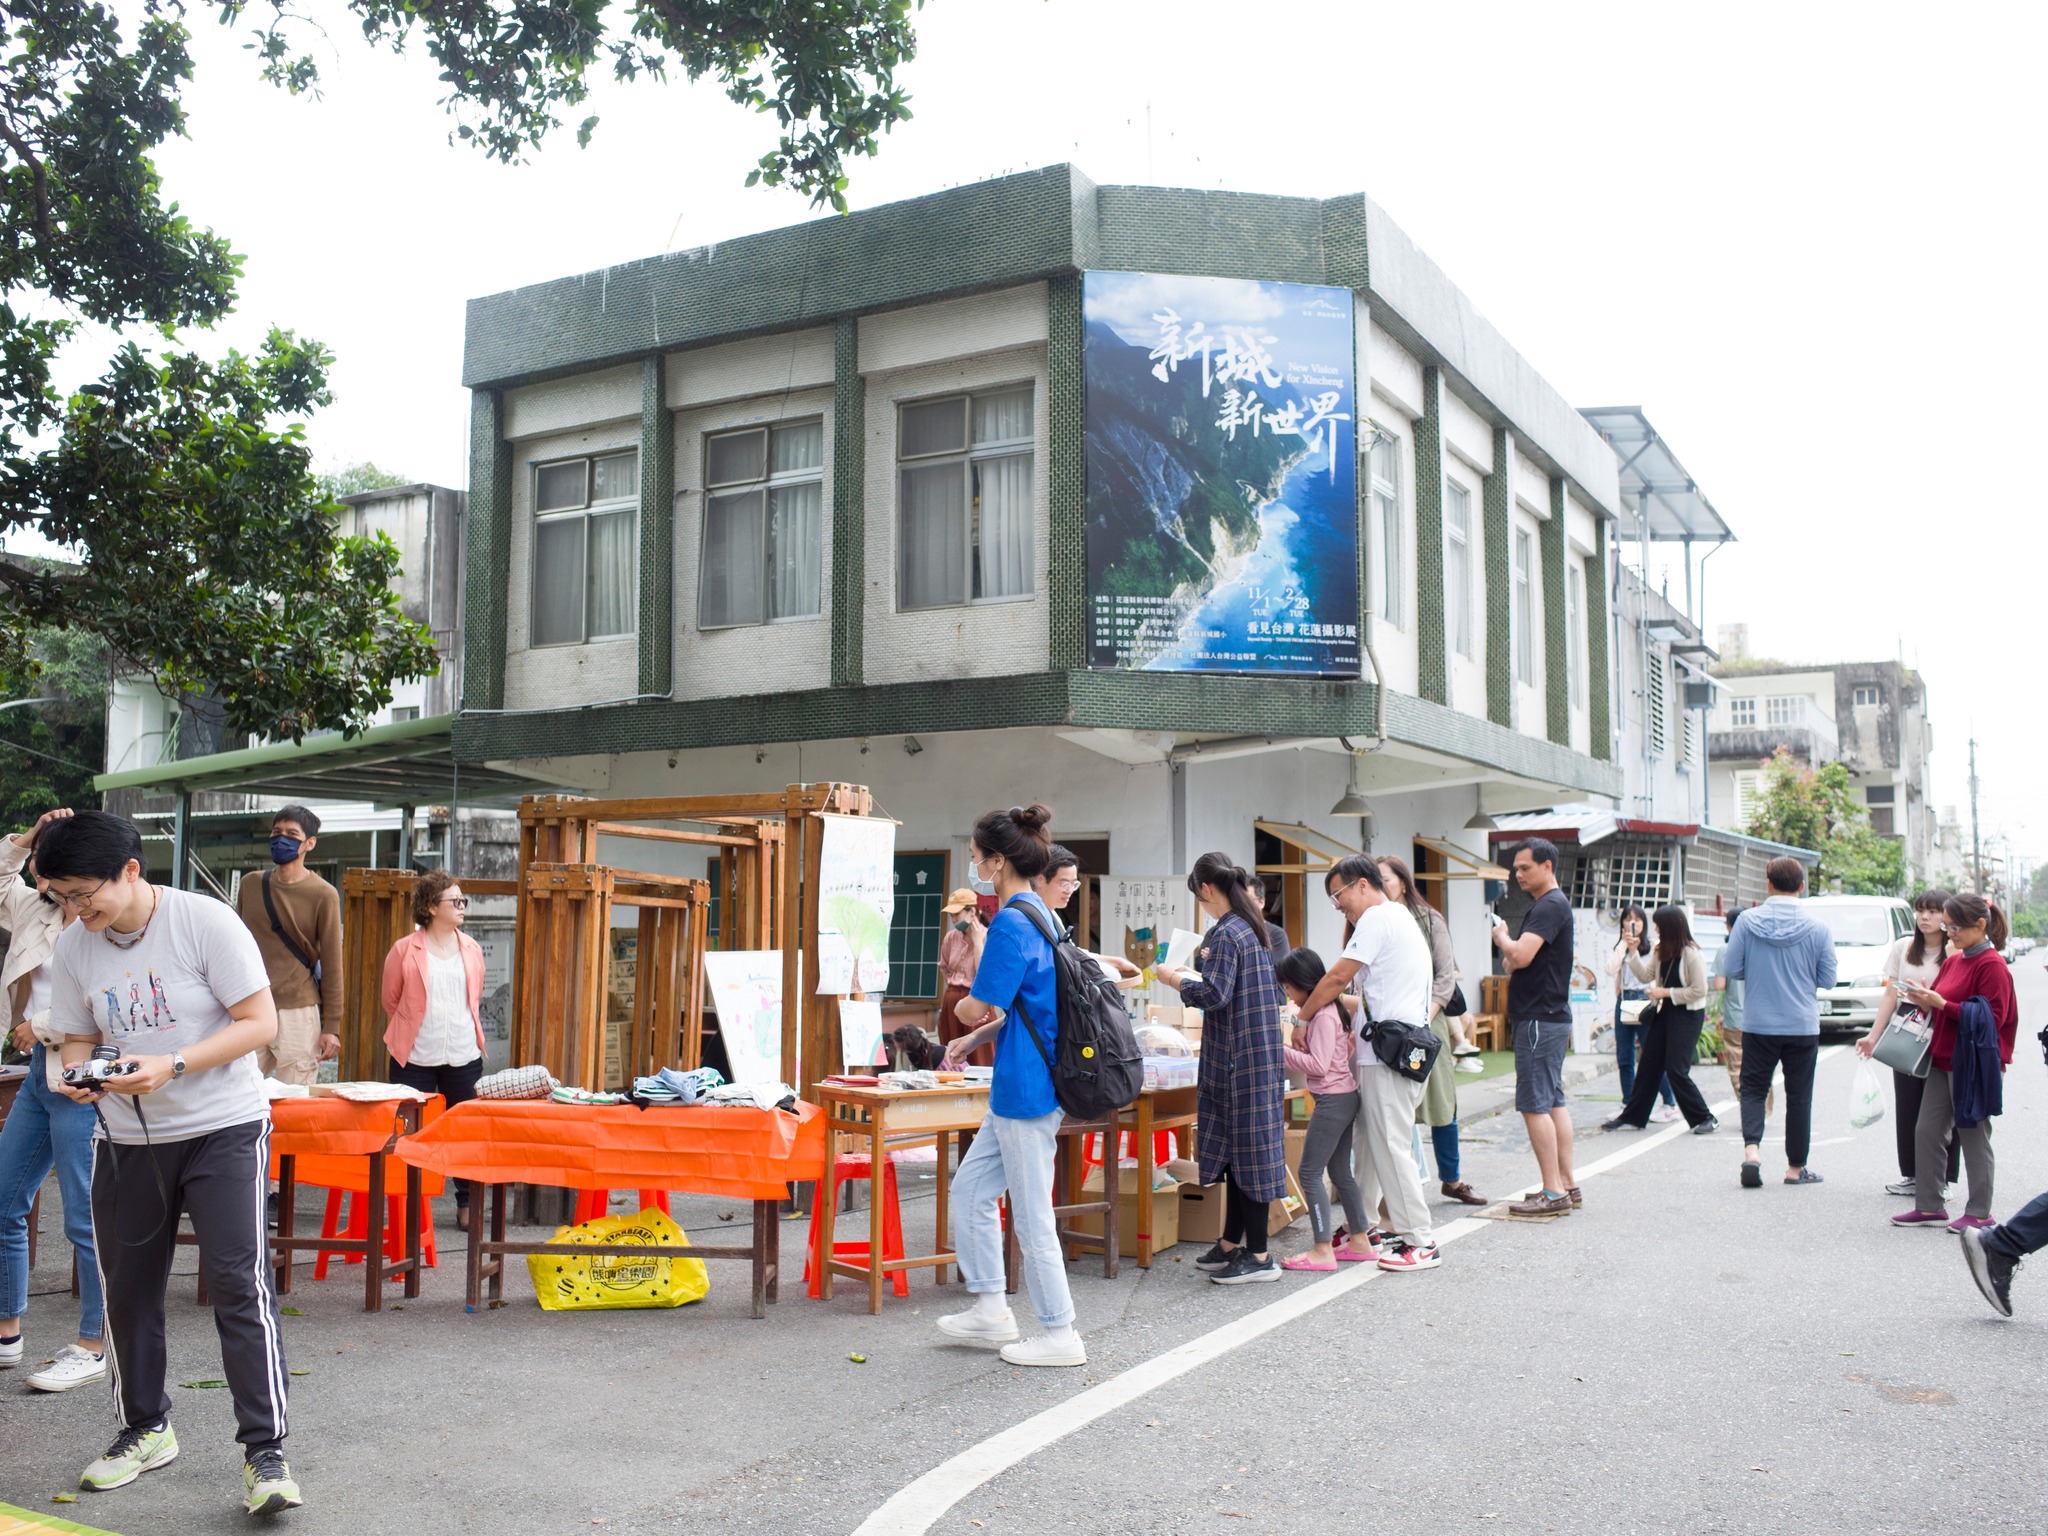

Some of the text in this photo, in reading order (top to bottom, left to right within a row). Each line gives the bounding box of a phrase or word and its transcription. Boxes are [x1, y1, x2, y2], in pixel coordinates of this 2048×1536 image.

[1149, 307, 1282, 397] 新城
[1288, 361, 1339, 375] New Vision
[1286, 373, 1344, 389] for Xincheng
[1215, 389, 1350, 486] 新世界
[1252, 608, 1268, 617] TUE
[1289, 609, 1305, 618] TUE
[1247, 621, 1357, 638] 看見台灣 花蓮攝影展
[1118, 880, 1166, 898] 當個文青
